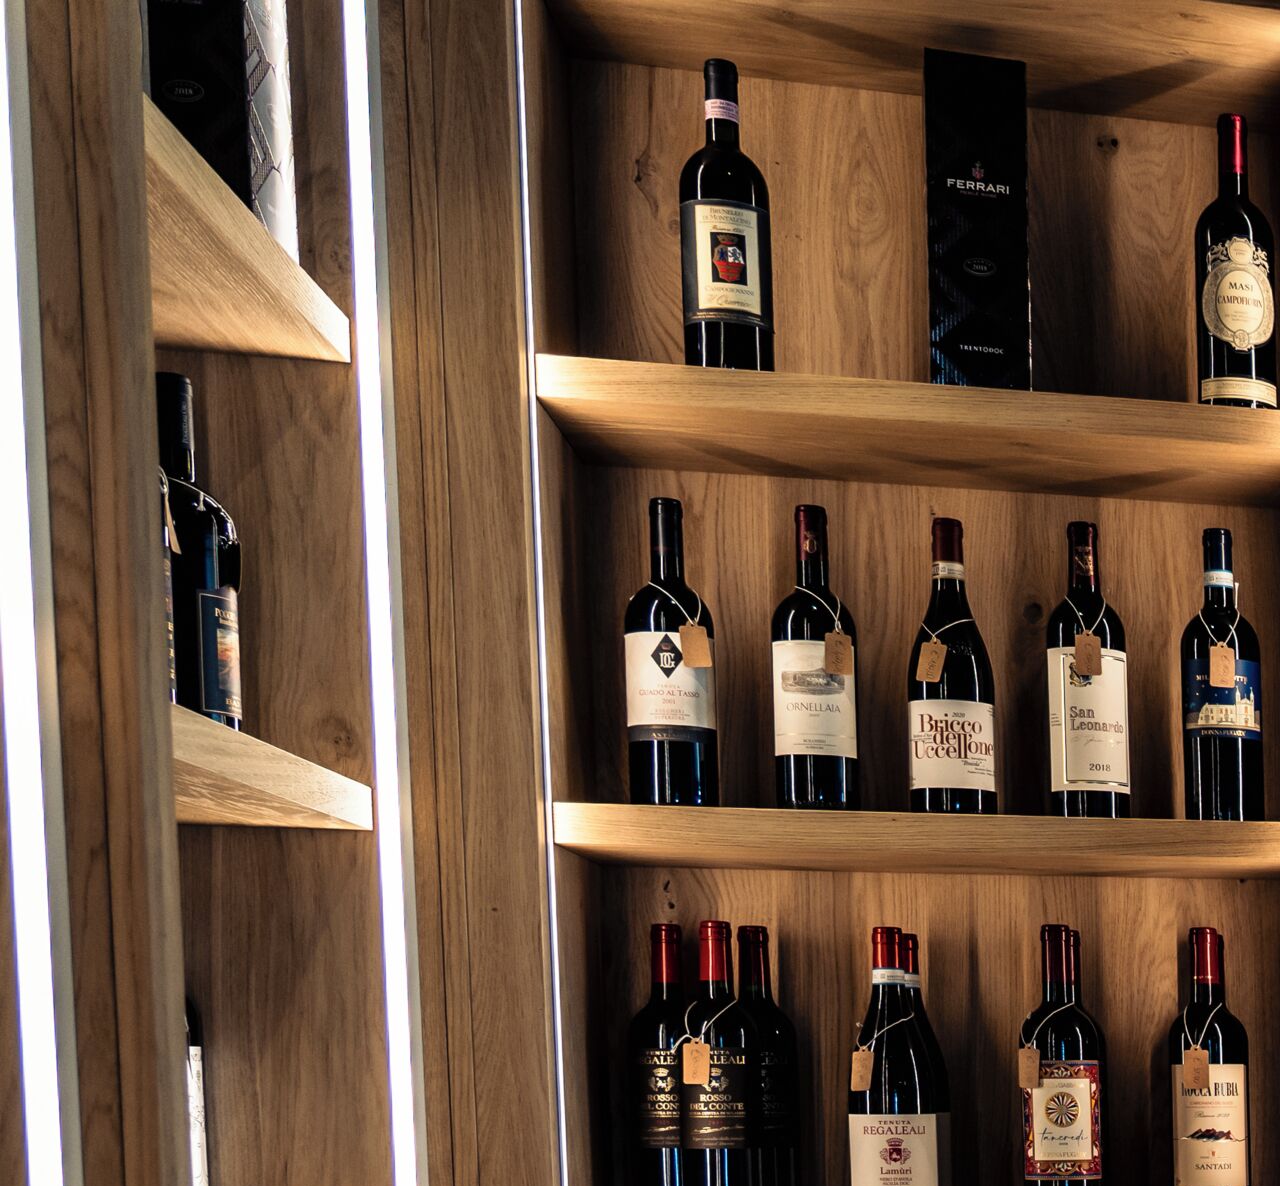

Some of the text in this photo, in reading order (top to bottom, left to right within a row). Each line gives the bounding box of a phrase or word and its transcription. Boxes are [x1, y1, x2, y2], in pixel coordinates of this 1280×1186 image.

[947, 178, 1010, 195] FERRARI
[1228, 281, 1254, 292] MASI
[960, 344, 1004, 355] TRENTODOC
[786, 702, 841, 713] ORNELLAIA
[1069, 706, 1095, 719] San
[918, 713, 982, 735] Bricco
[1070, 719, 1124, 734] Leonardo
[1089, 763, 1111, 772] 2018
[1214, 1082, 1239, 1097] RUBIA
[646, 1094, 679, 1102] ROSSO
[700, 1094, 732, 1102] ROSSO
[863, 1126, 926, 1135] REGALEALI
[880, 1167, 912, 1175] Lamùri
